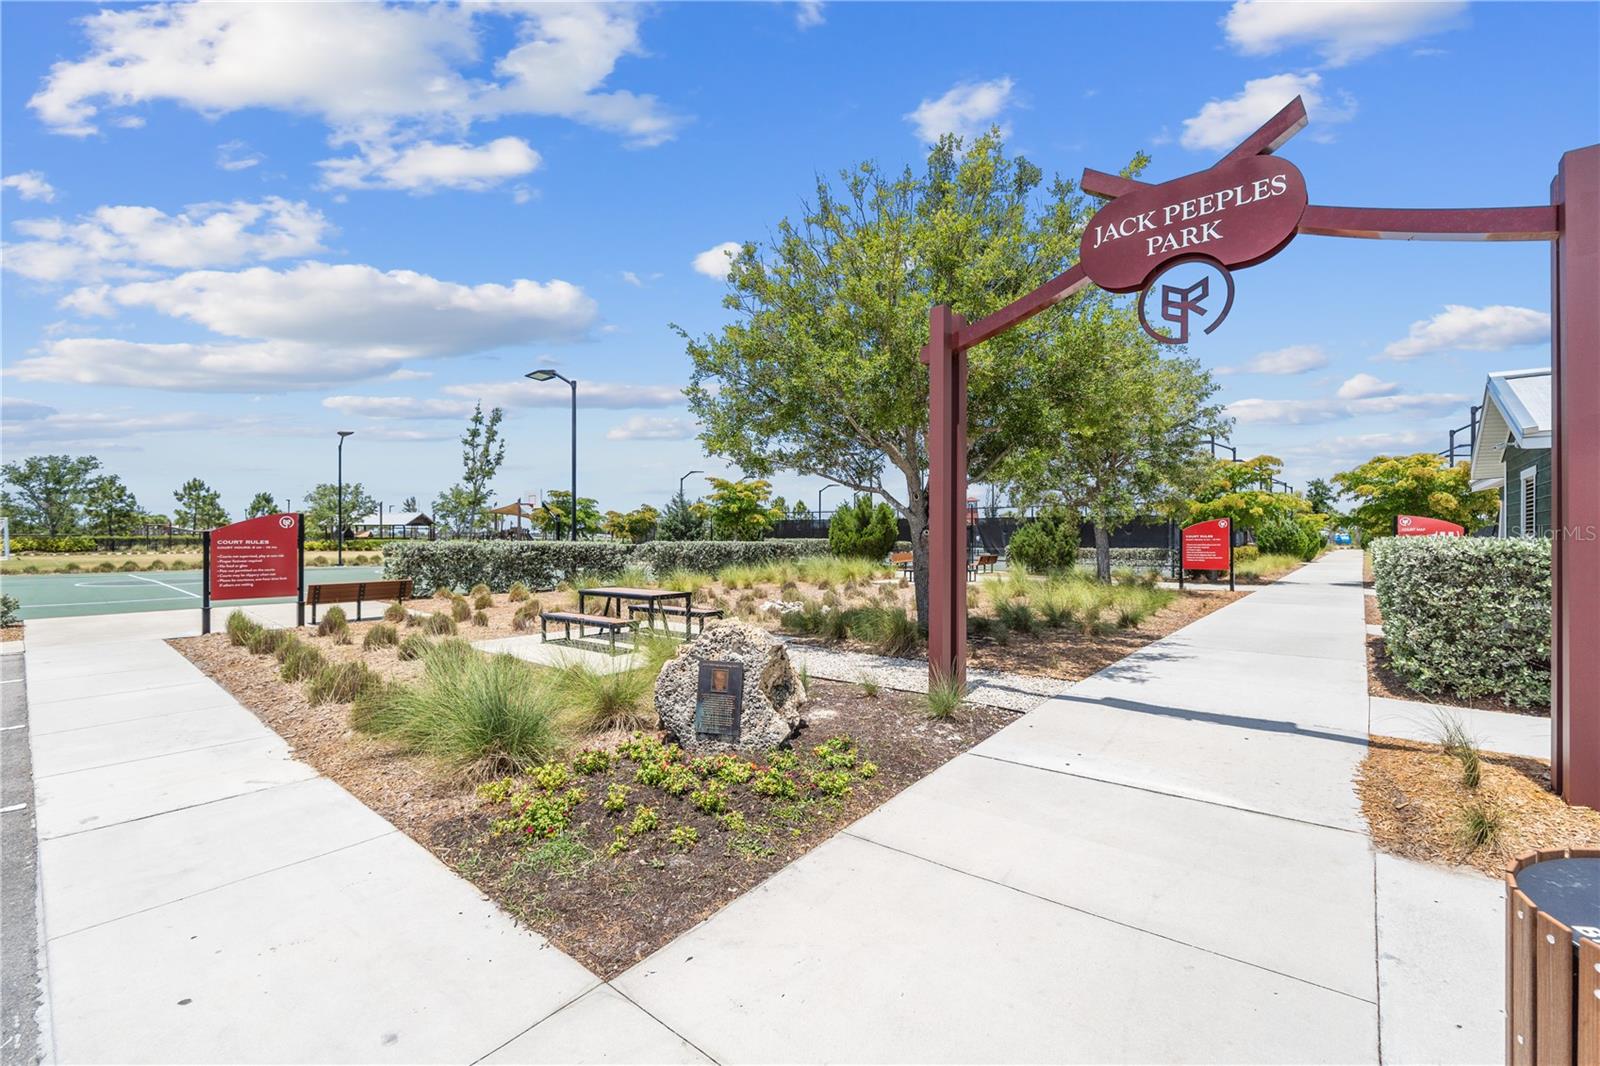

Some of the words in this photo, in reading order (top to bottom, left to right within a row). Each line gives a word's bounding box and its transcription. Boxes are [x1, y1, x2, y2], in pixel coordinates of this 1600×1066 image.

[1093, 210, 1157, 249] JACK
[1163, 174, 1287, 226] PEEPLES
[1146, 219, 1223, 257] PARK
